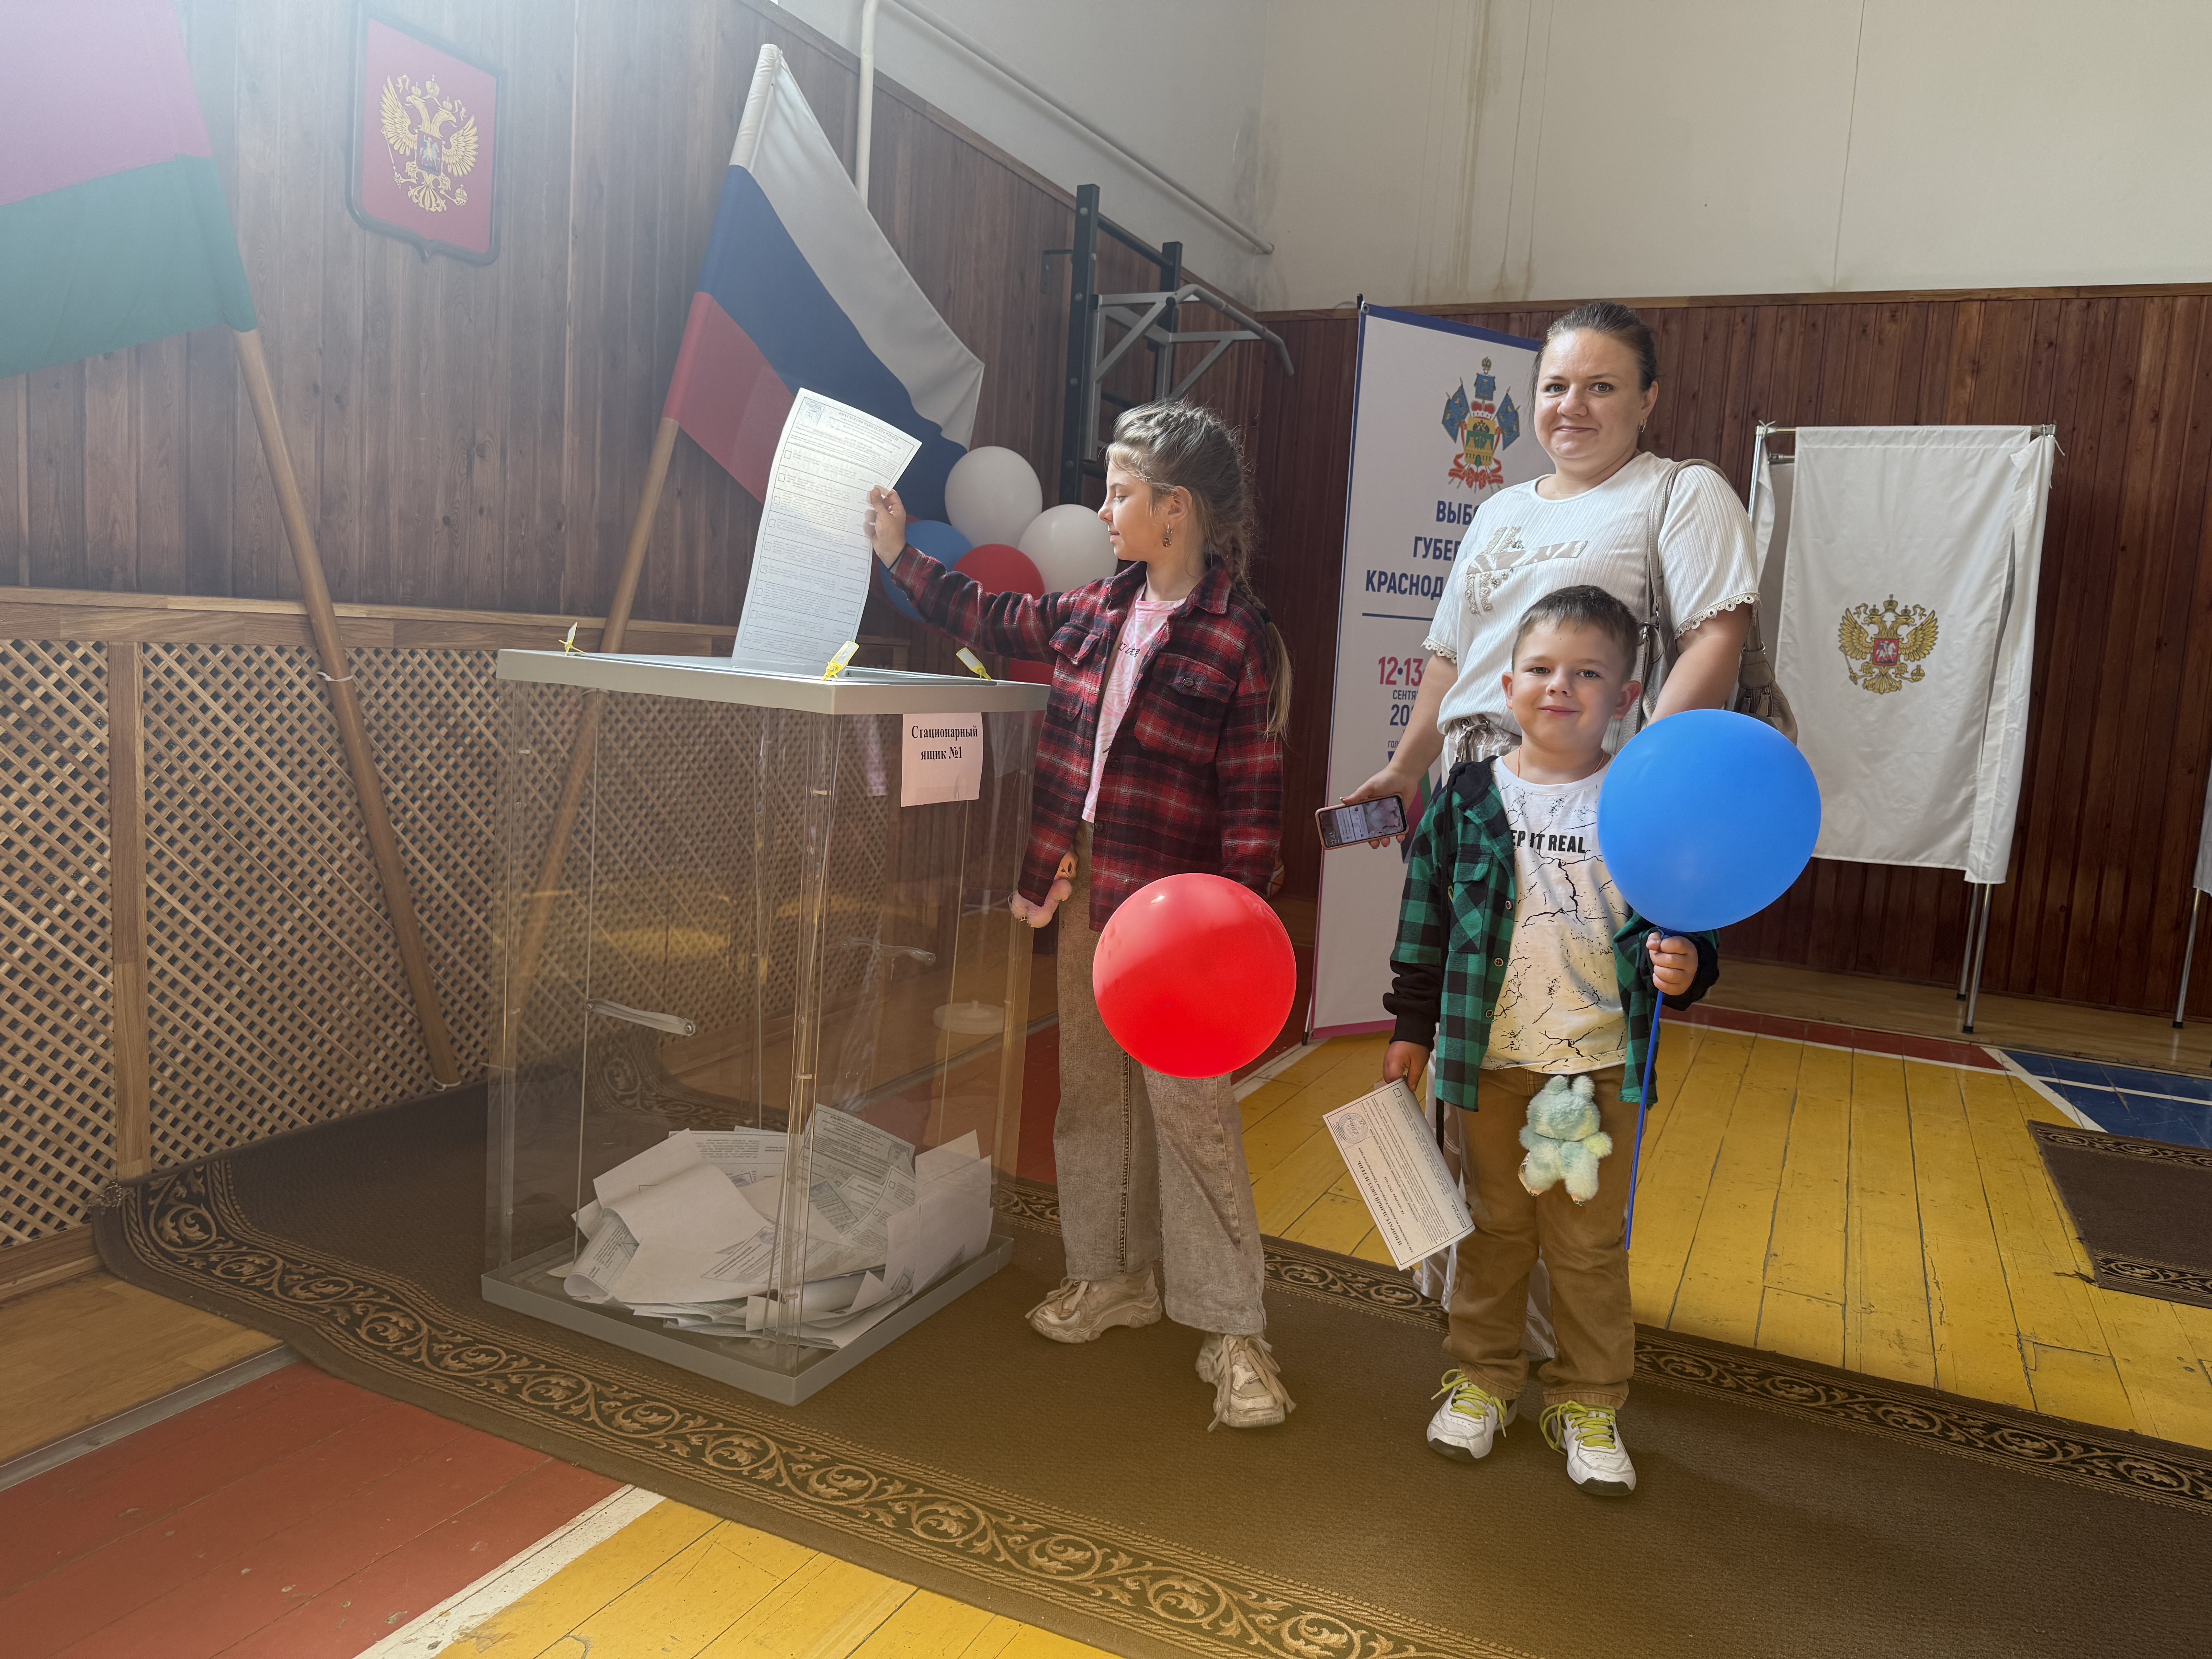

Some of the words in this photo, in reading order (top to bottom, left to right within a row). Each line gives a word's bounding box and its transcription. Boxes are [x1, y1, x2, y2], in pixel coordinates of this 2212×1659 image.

[1365, 570, 1444, 600] КРАСНОД
[1393, 689, 1418, 700] СЕНТЯ
[1390, 704, 1414, 726] 20
[911, 725, 977, 740] Стационарный
[921, 750, 946, 760] ящик
[948, 746, 962, 759] №1
[1530, 833, 1545, 850] IT
[1548, 835, 1585, 853] REAL
[1357, 1161, 1376, 1196] БЮЛЛЕТЕНЬ
[1374, 1196, 1402, 1246] ИЗБИРАТЕЛЬНЫЙ
